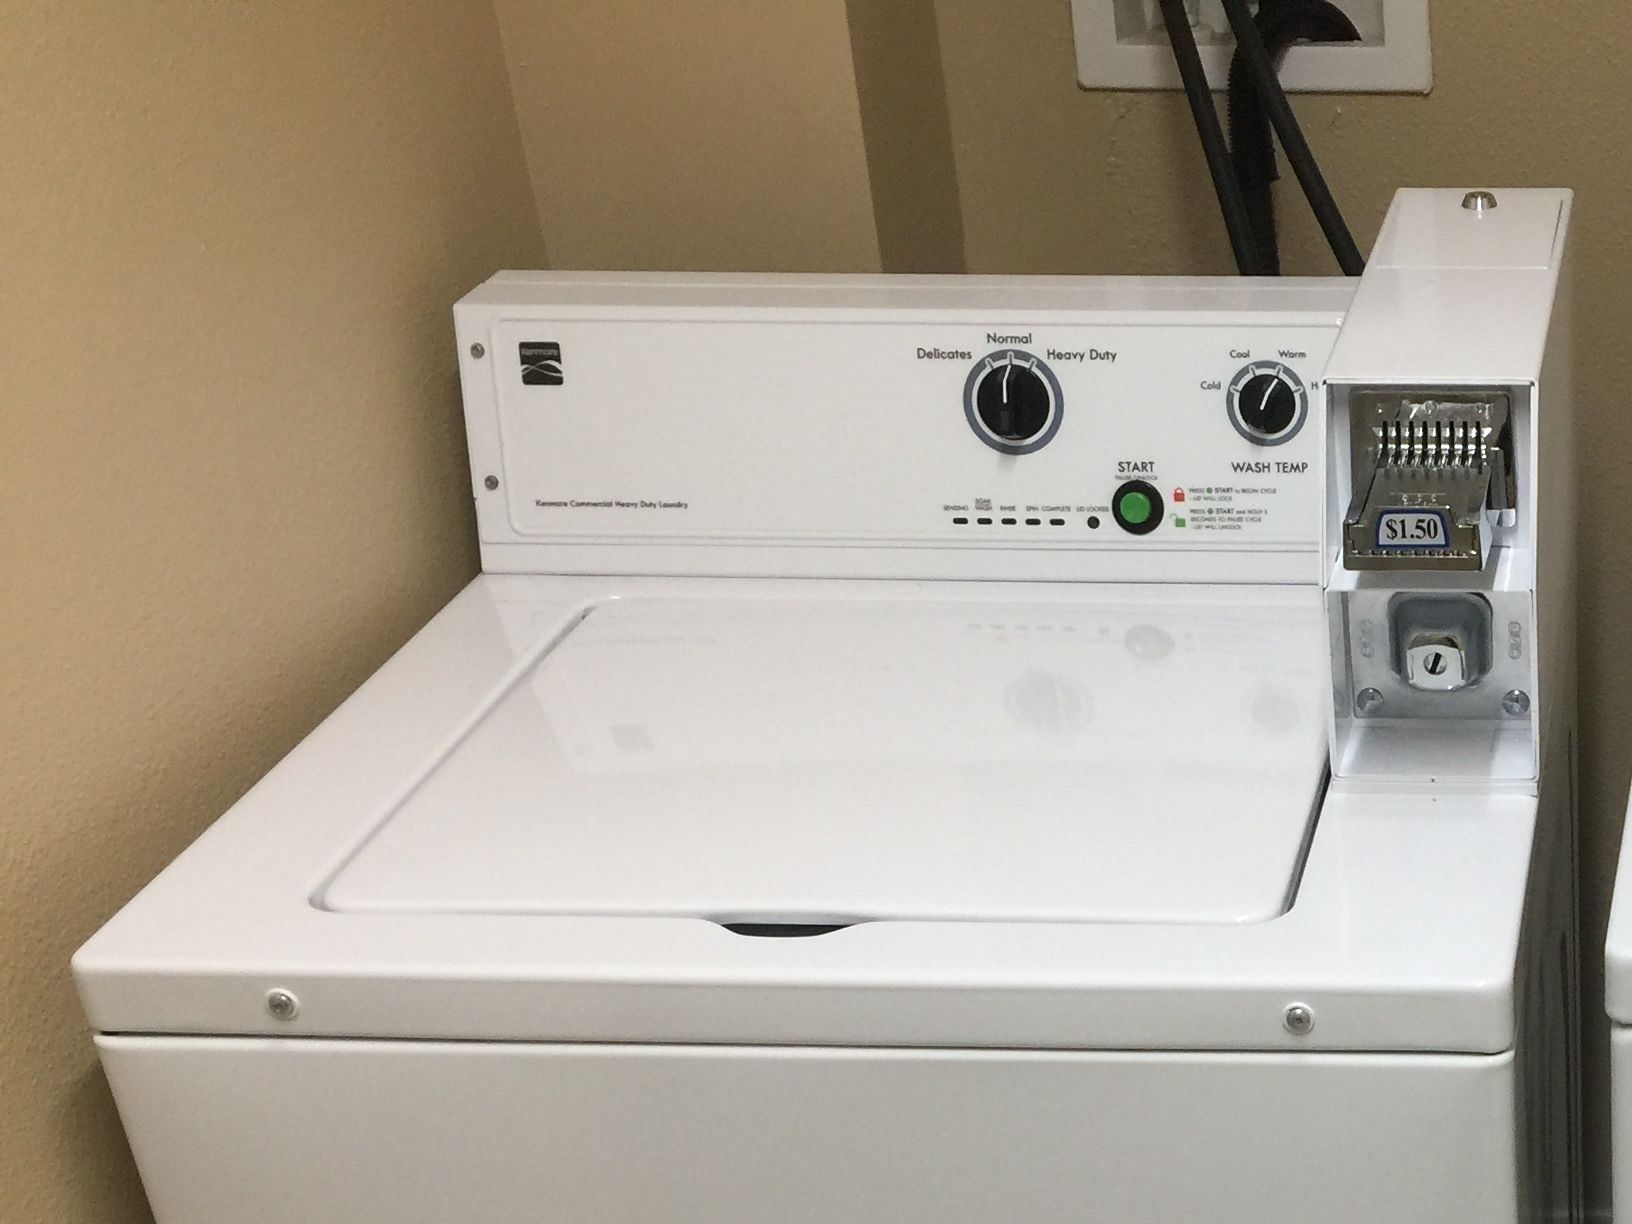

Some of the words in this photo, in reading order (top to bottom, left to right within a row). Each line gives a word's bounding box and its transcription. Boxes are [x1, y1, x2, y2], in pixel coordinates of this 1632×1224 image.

[986, 333, 1032, 344] Normal
[917, 348, 972, 360] Delicates
[1047, 349, 1085, 362] Heavy
[1089, 349, 1117, 362] Duty
[1229, 349, 1250, 359] Cool
[1278, 349, 1307, 359] Warm
[1200, 381, 1221, 390] Cold
[1117, 461, 1155, 473] START
[1231, 462, 1271, 473] WASH
[1275, 462, 1309, 474] TEMP
[615, 500, 638, 509] Heavy
[640, 500, 656, 509] Duty
[659, 501, 688, 509] Laundry
[1385, 518, 1438, 540] $1.50
